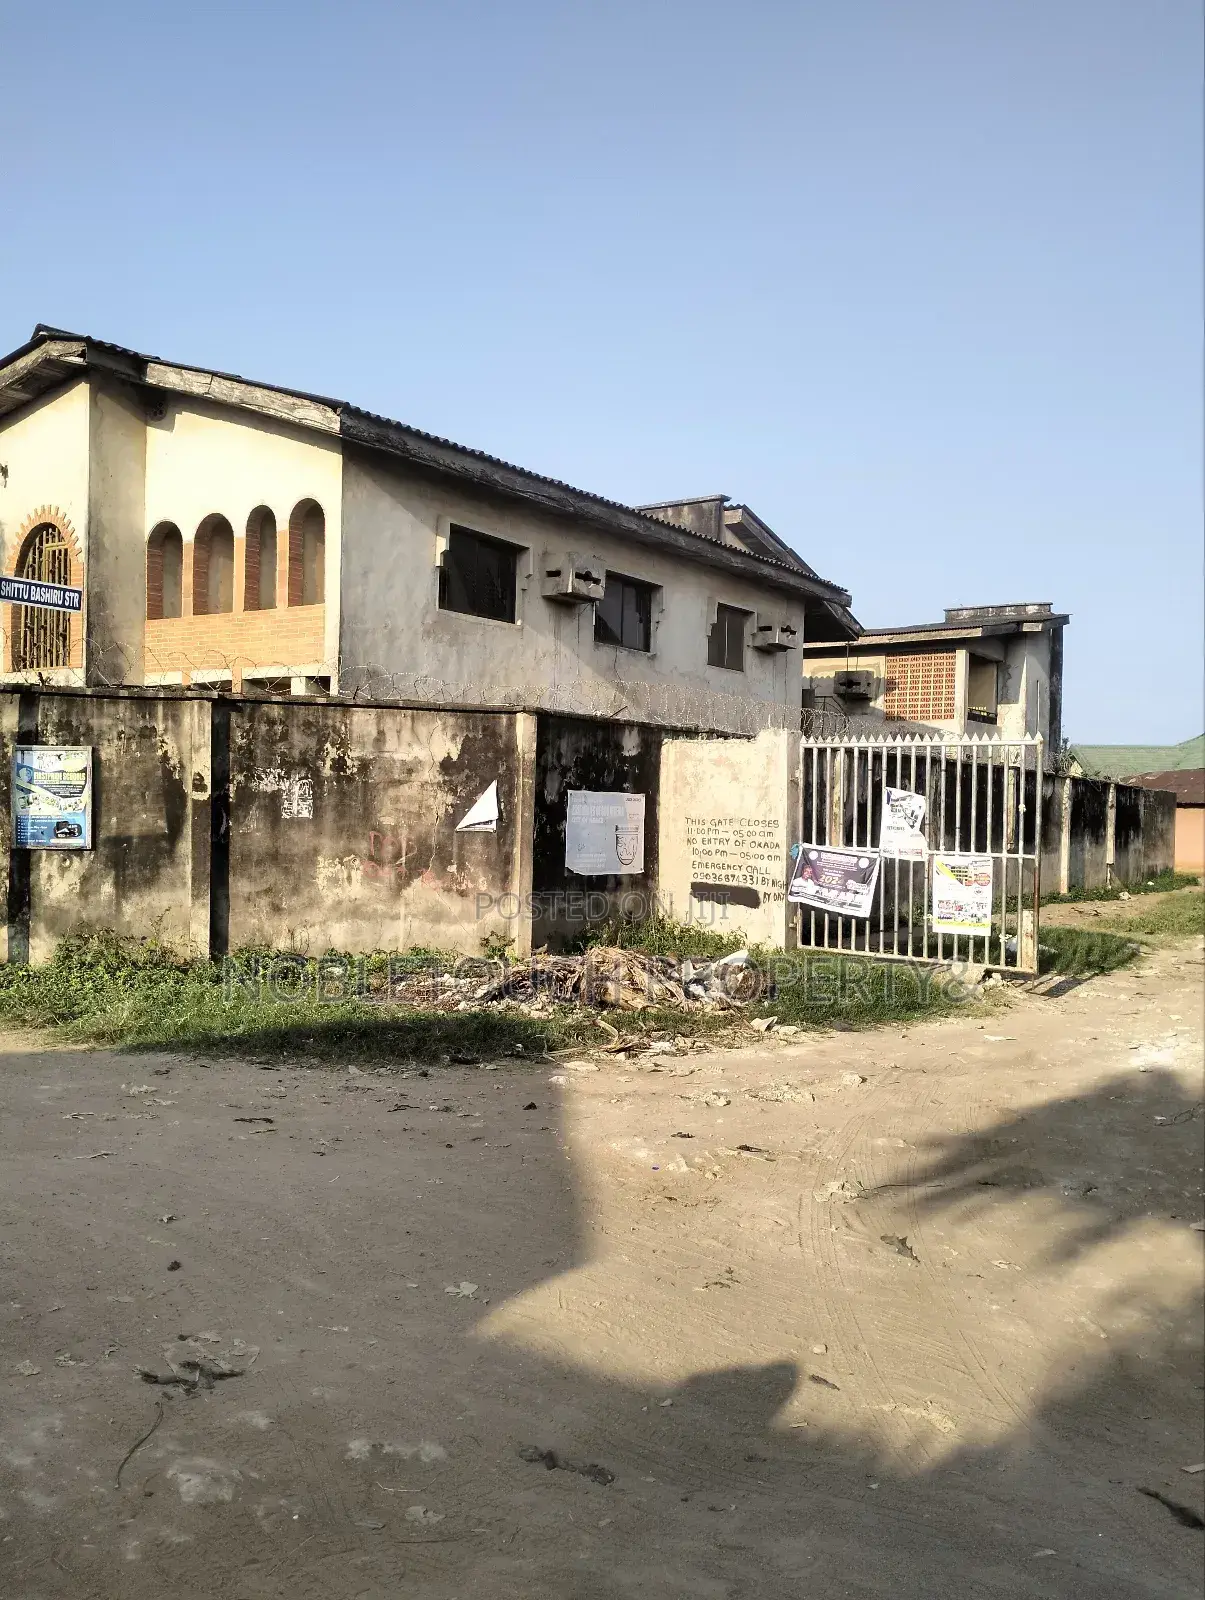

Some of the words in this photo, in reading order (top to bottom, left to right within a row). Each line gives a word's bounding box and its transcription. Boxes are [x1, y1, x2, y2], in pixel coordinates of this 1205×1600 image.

[1, 581, 29, 599] SHITTU
[31, 586, 63, 605] BASHIRU
[65, 591, 80, 608] STR
[685, 817, 706, 826] THIS
[710, 818, 734, 828] GATE
[739, 818, 780, 829] CLOSES
[686, 837, 698, 847] NO
[702, 838, 731, 847] ENTRY
[734, 840, 746, 848] OF
[750, 841, 780, 850] OKADA
[746, 865, 771, 876] CALL
[760, 876, 770, 887] BY
[763, 892, 772, 904] BY
